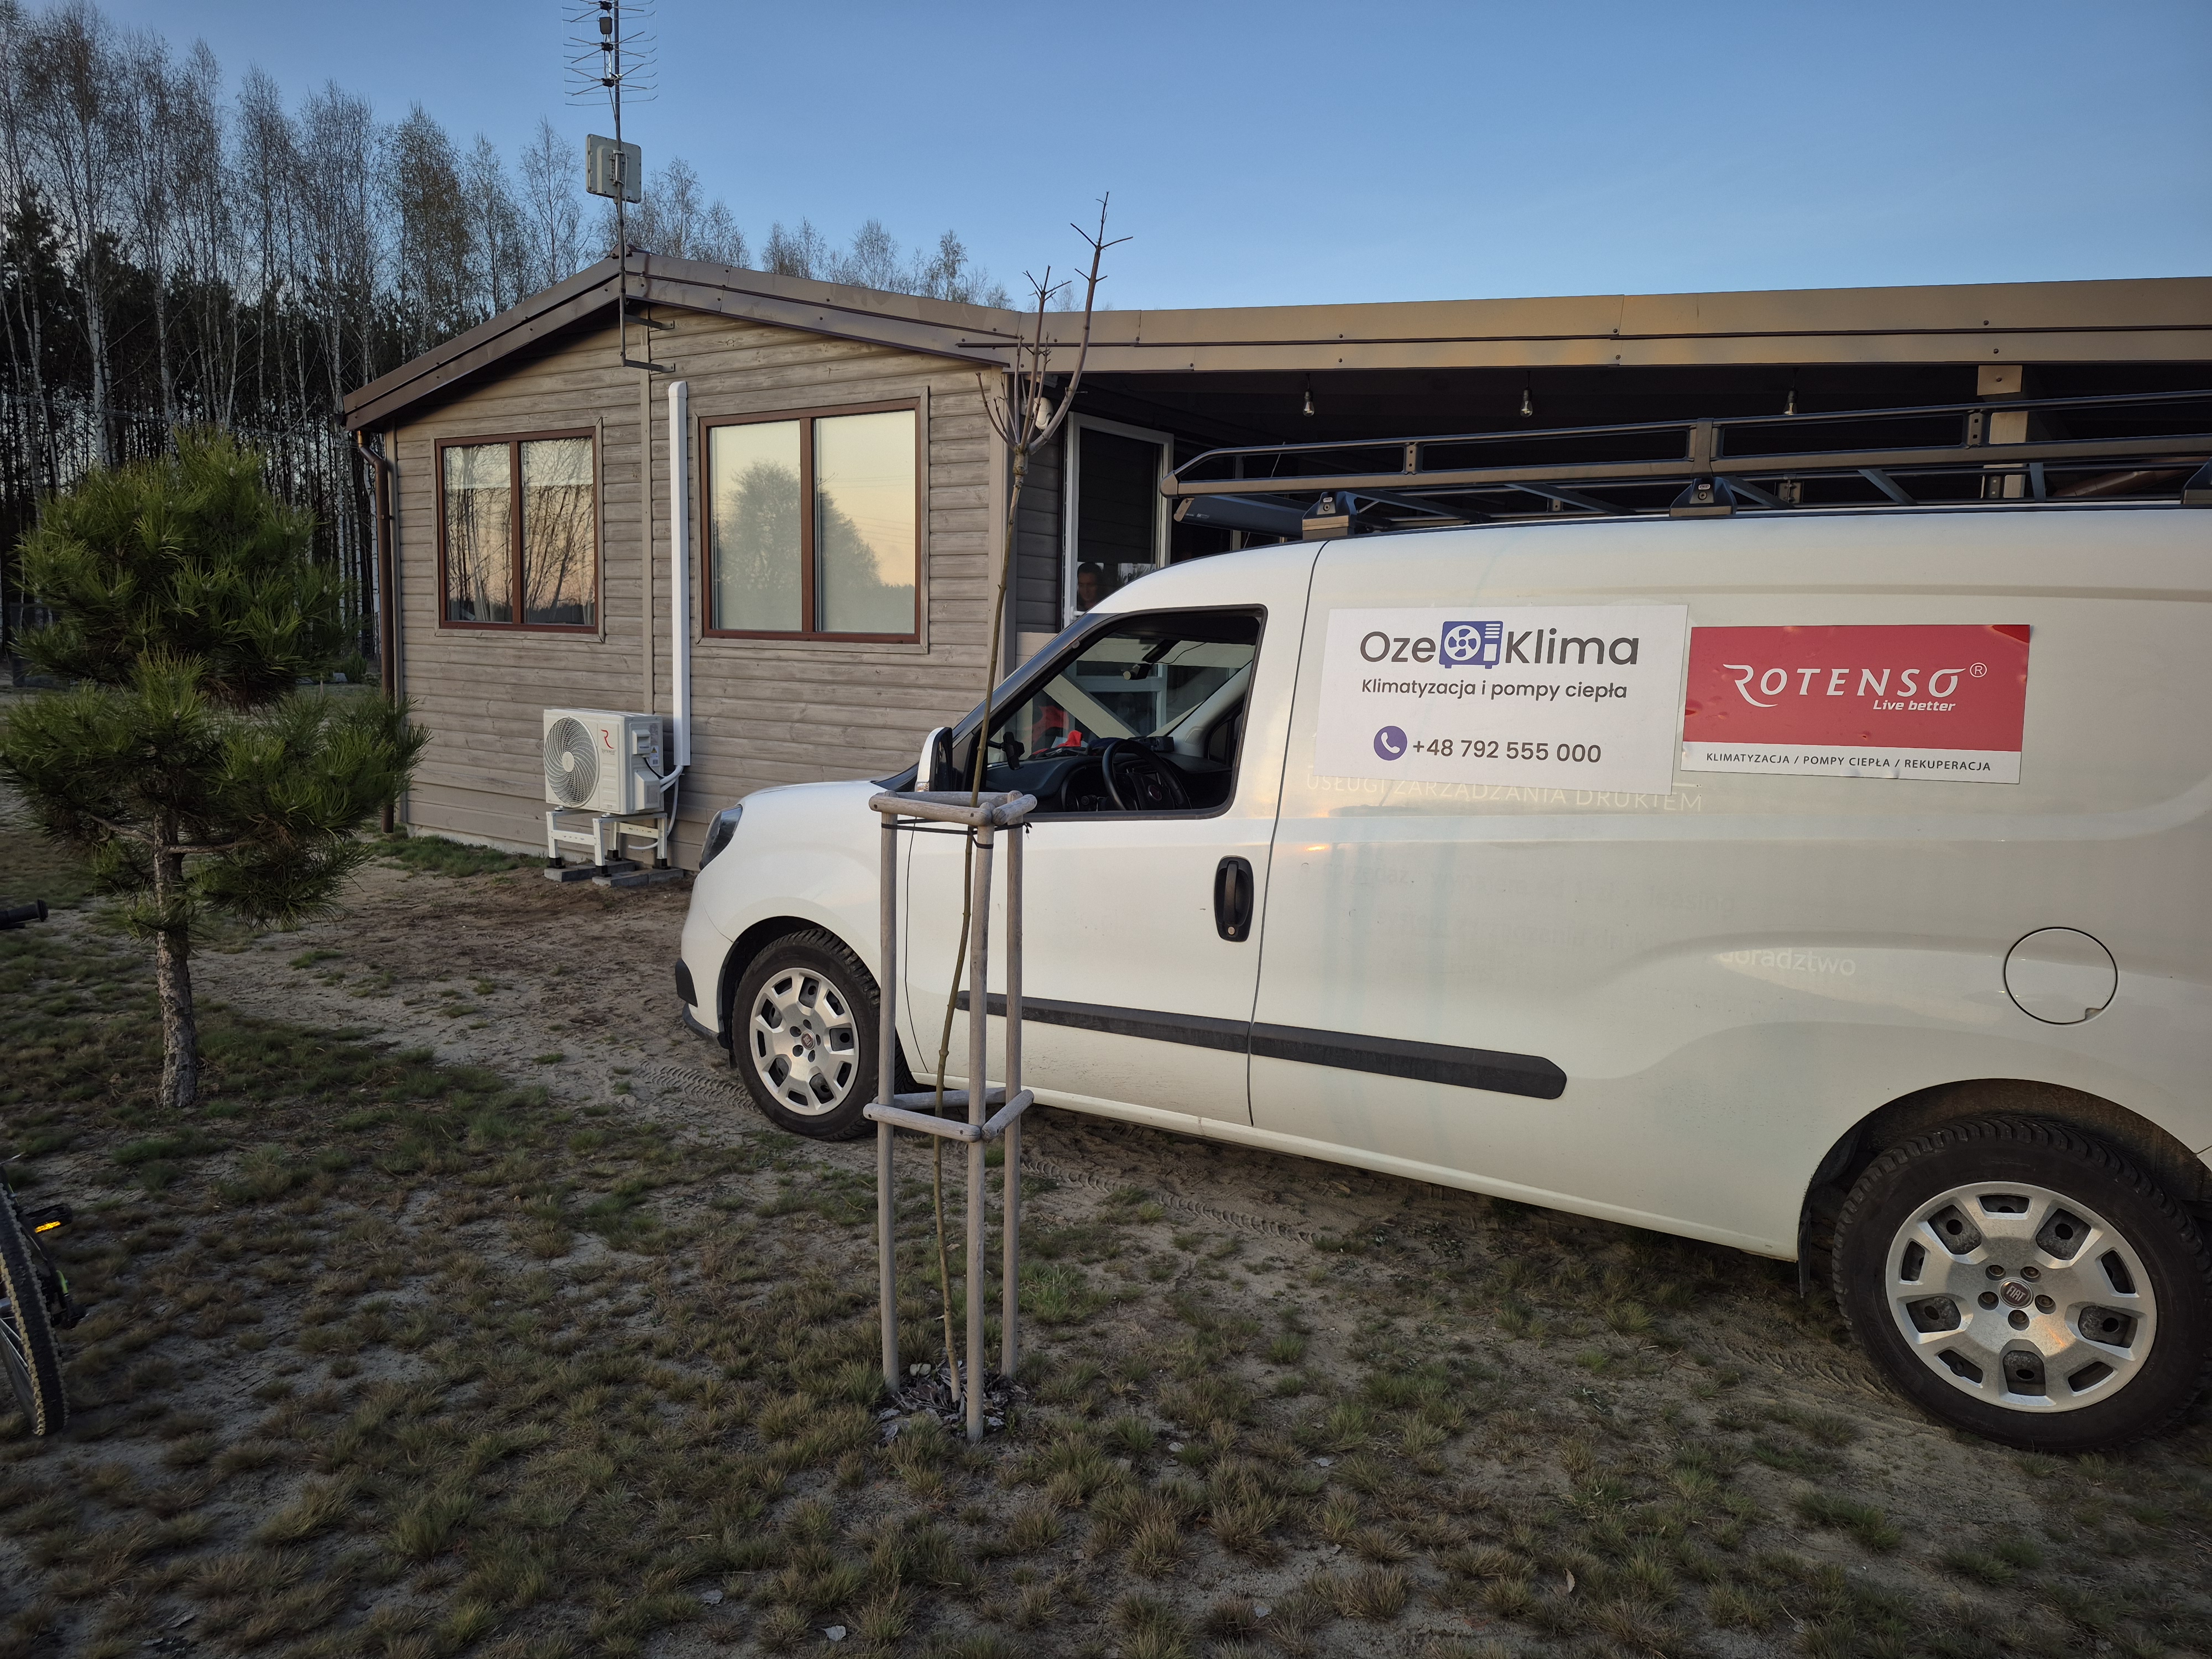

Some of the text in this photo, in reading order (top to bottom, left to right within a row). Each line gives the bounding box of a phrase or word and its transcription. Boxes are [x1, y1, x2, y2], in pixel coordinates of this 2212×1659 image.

[1360, 628, 1640, 665] Oze Klima
[1361, 678, 1627, 703] Klimatyzacja i pompy ciepła
[1872, 700, 1956, 711] Live better
[1412, 739, 1601, 763] +48 792 555 000
[1707, 753, 1790, 764] KLIMATYZACJA
[1803, 756, 1845, 766] POMPY
[1849, 757, 1890, 767] CIEPŁA
[1904, 759, 1991, 771] REKUPERACJA
[2006, 1285, 2026, 1301] FIAT
